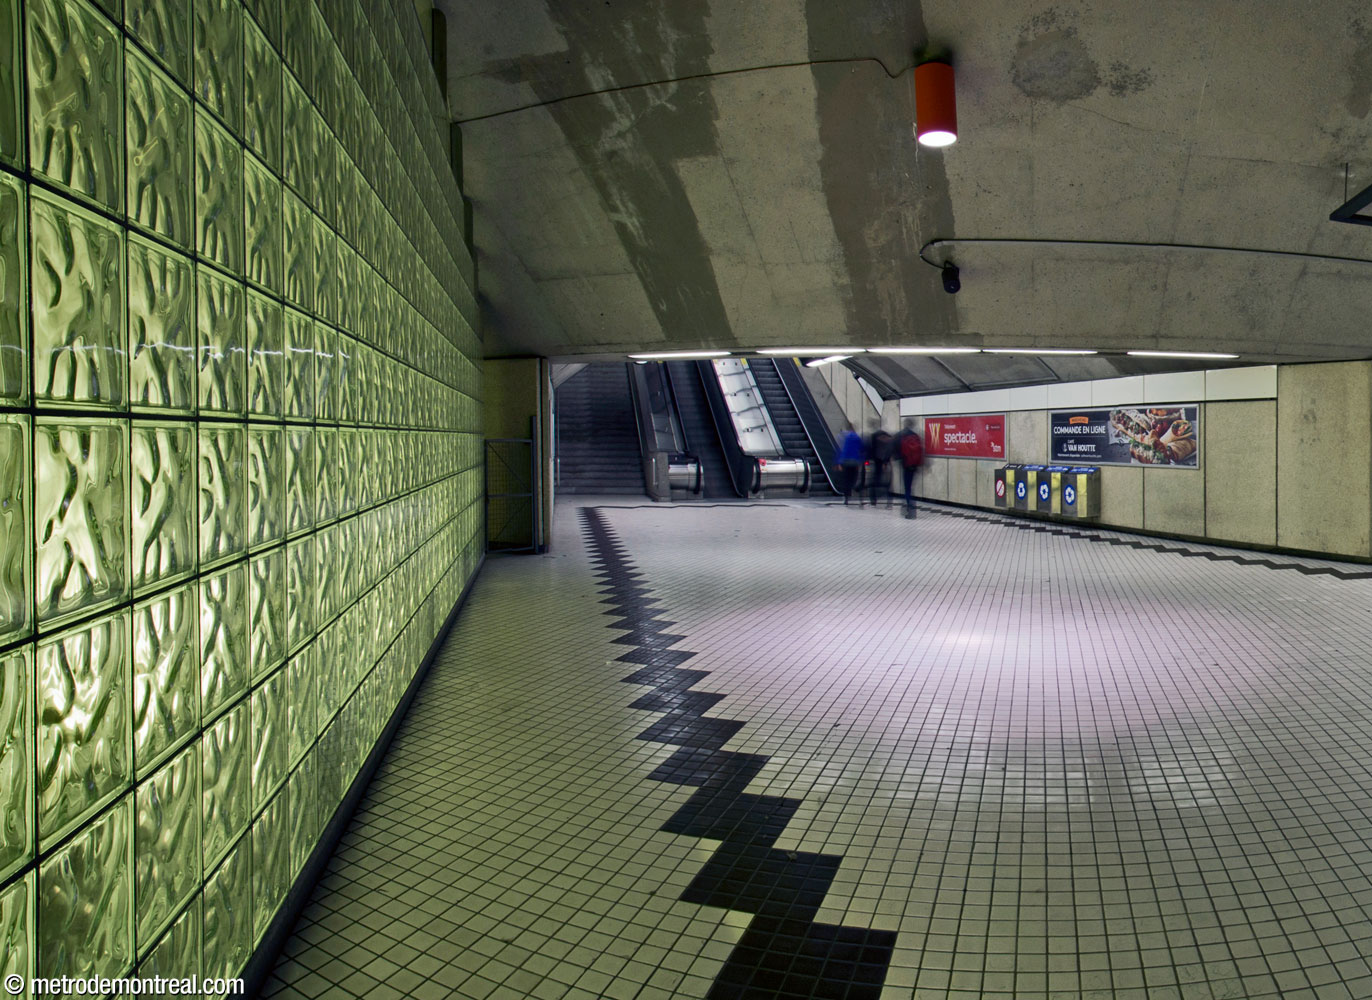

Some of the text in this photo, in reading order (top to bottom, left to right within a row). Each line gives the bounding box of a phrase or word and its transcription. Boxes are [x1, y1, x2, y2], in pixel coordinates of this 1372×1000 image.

[1053, 425, 1106, 434] COMMANDE EN LIGNE
[944, 430, 977, 445] spectacle.
[1067, 444, 1096, 452] VAN HOUTTE
